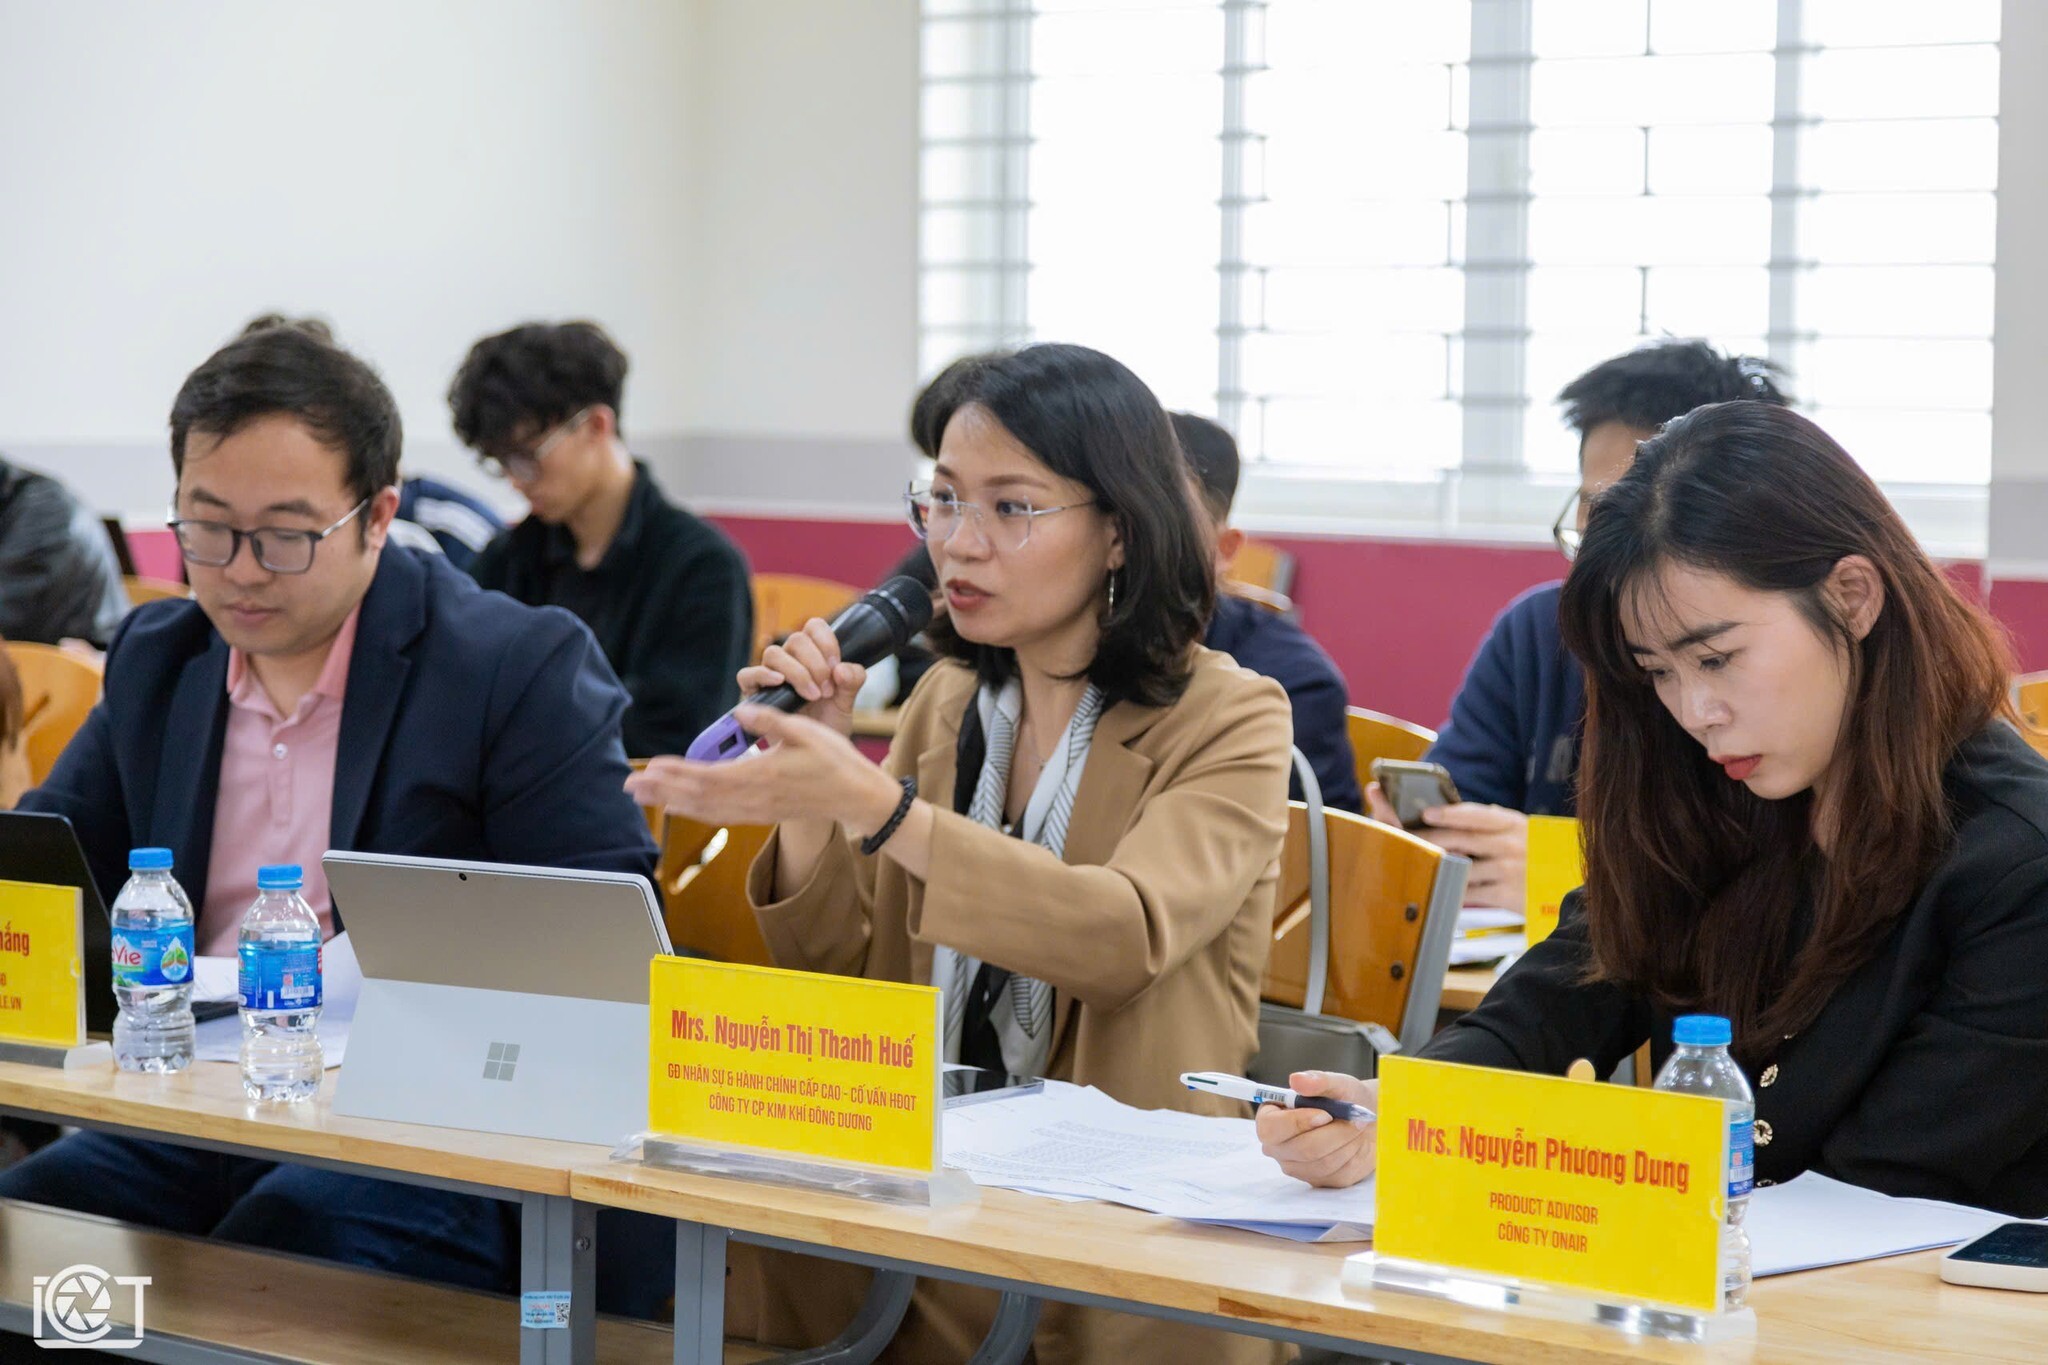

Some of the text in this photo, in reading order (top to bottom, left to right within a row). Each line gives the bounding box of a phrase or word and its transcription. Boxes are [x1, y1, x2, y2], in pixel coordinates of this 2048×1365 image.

[671, 1009, 916, 1069] Mrs. Nguyễn Thị Thanh Huế
[668, 1062, 681, 1079] GĐ
[683, 1063, 710, 1083] NHÂN
[712, 1068, 725, 1088] SỰ
[727, 1071, 734, 1086] &
[736, 1070, 763, 1090] HÀNH
[766, 1075, 797, 1095] CHÍNH
[799, 1077, 819, 1097] CẤP
[821, 1083, 841, 1101] CAO
[850, 1083, 865, 1104] CỐ
[866, 1086, 887, 1107] VẤN
[889, 1092, 917, 1112] HĐQT
[709, 1092, 873, 1131] CÔNG TY CP KIM KHÍ ĐÔNG DƯƠNG
[1407, 1118, 1690, 1194] Mrs. Nguyễn Phương Dung
[1489, 1192, 1599, 1225] PRODUCT ADVISOR
[1498, 1221, 1588, 1253] CÔNG TY ONAIR
